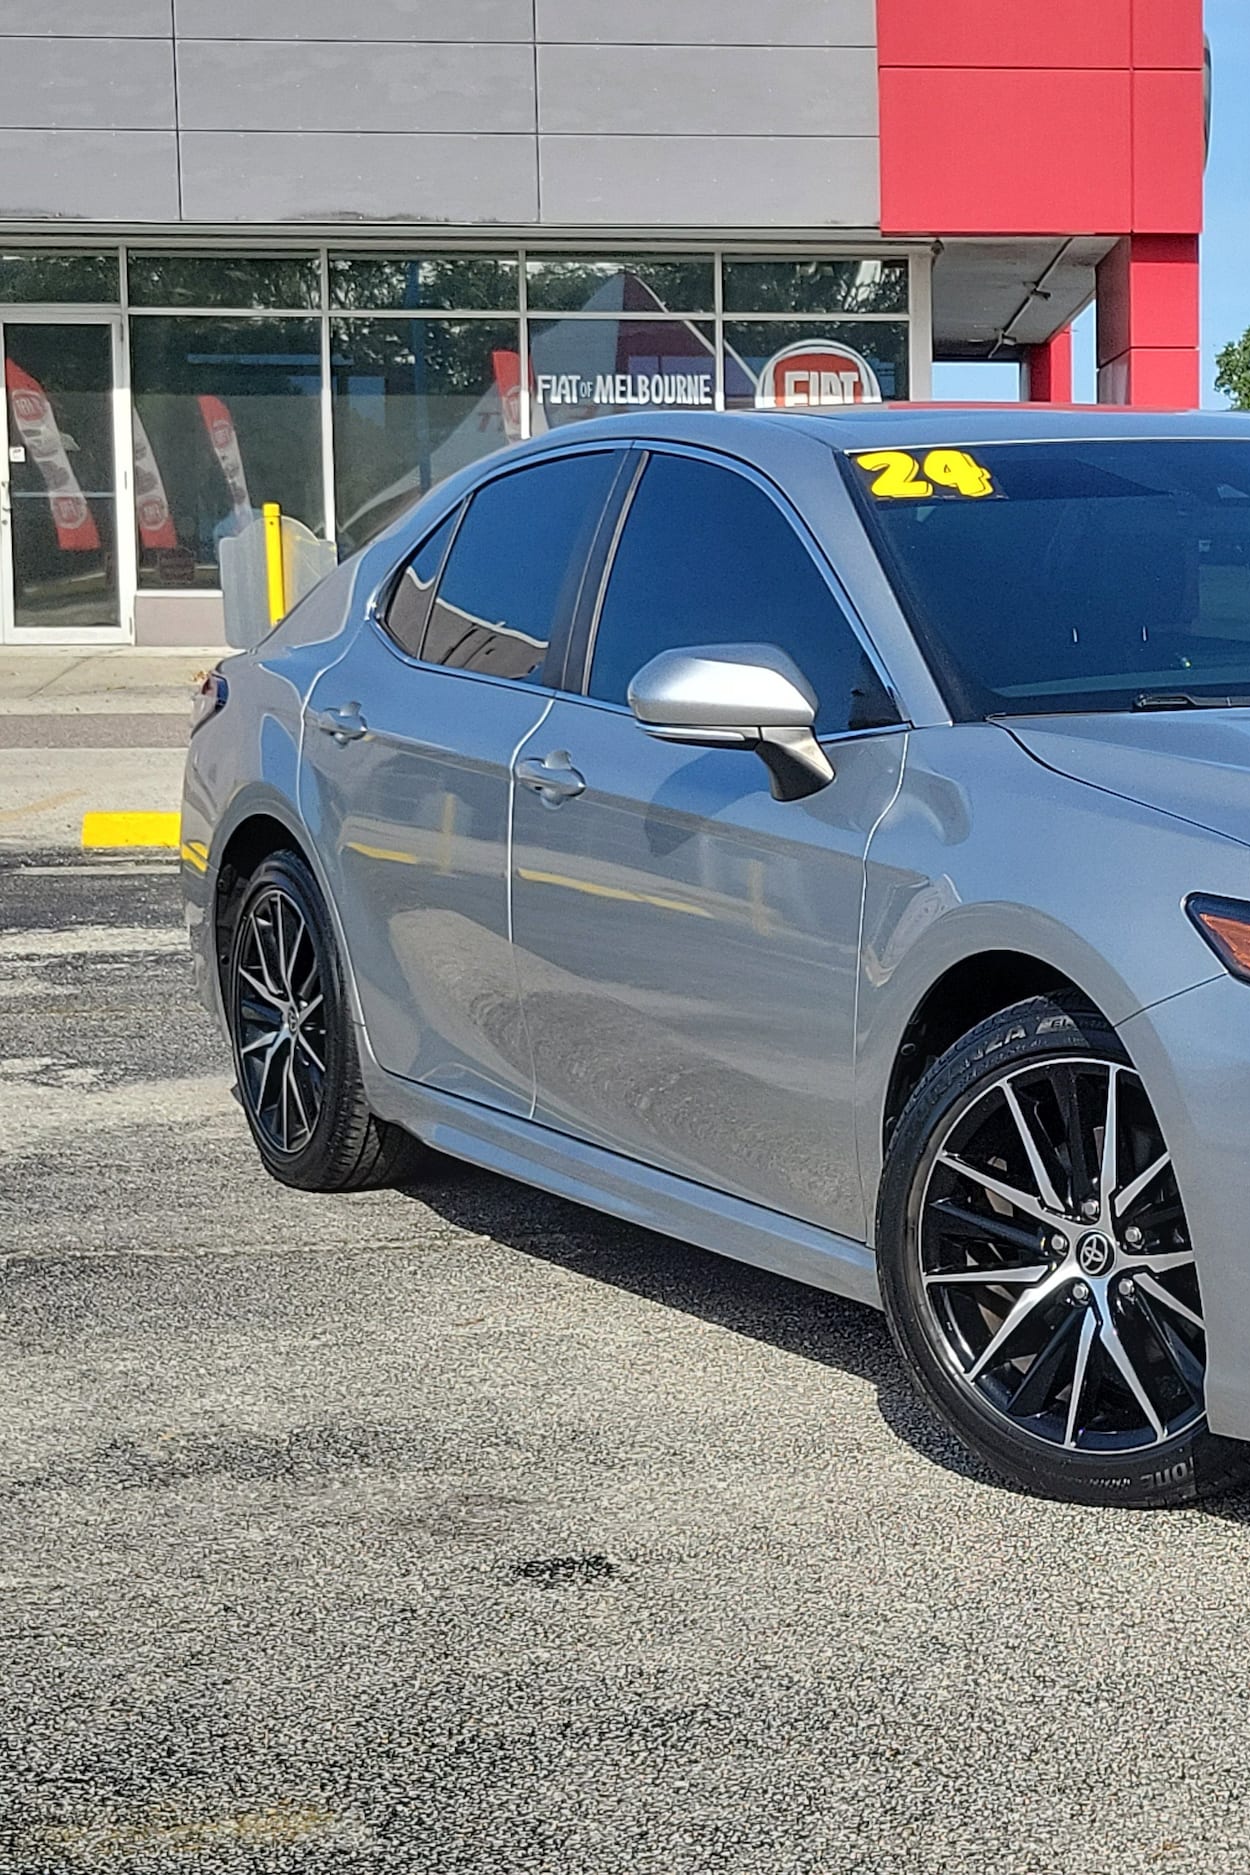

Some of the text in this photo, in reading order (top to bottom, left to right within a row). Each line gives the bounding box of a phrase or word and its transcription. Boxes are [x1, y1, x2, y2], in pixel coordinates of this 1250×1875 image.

[537, 374, 713, 406] FIAT OF MELBOURNE
[785, 370, 860, 407] FIAT
[856, 450, 994, 498] 24
